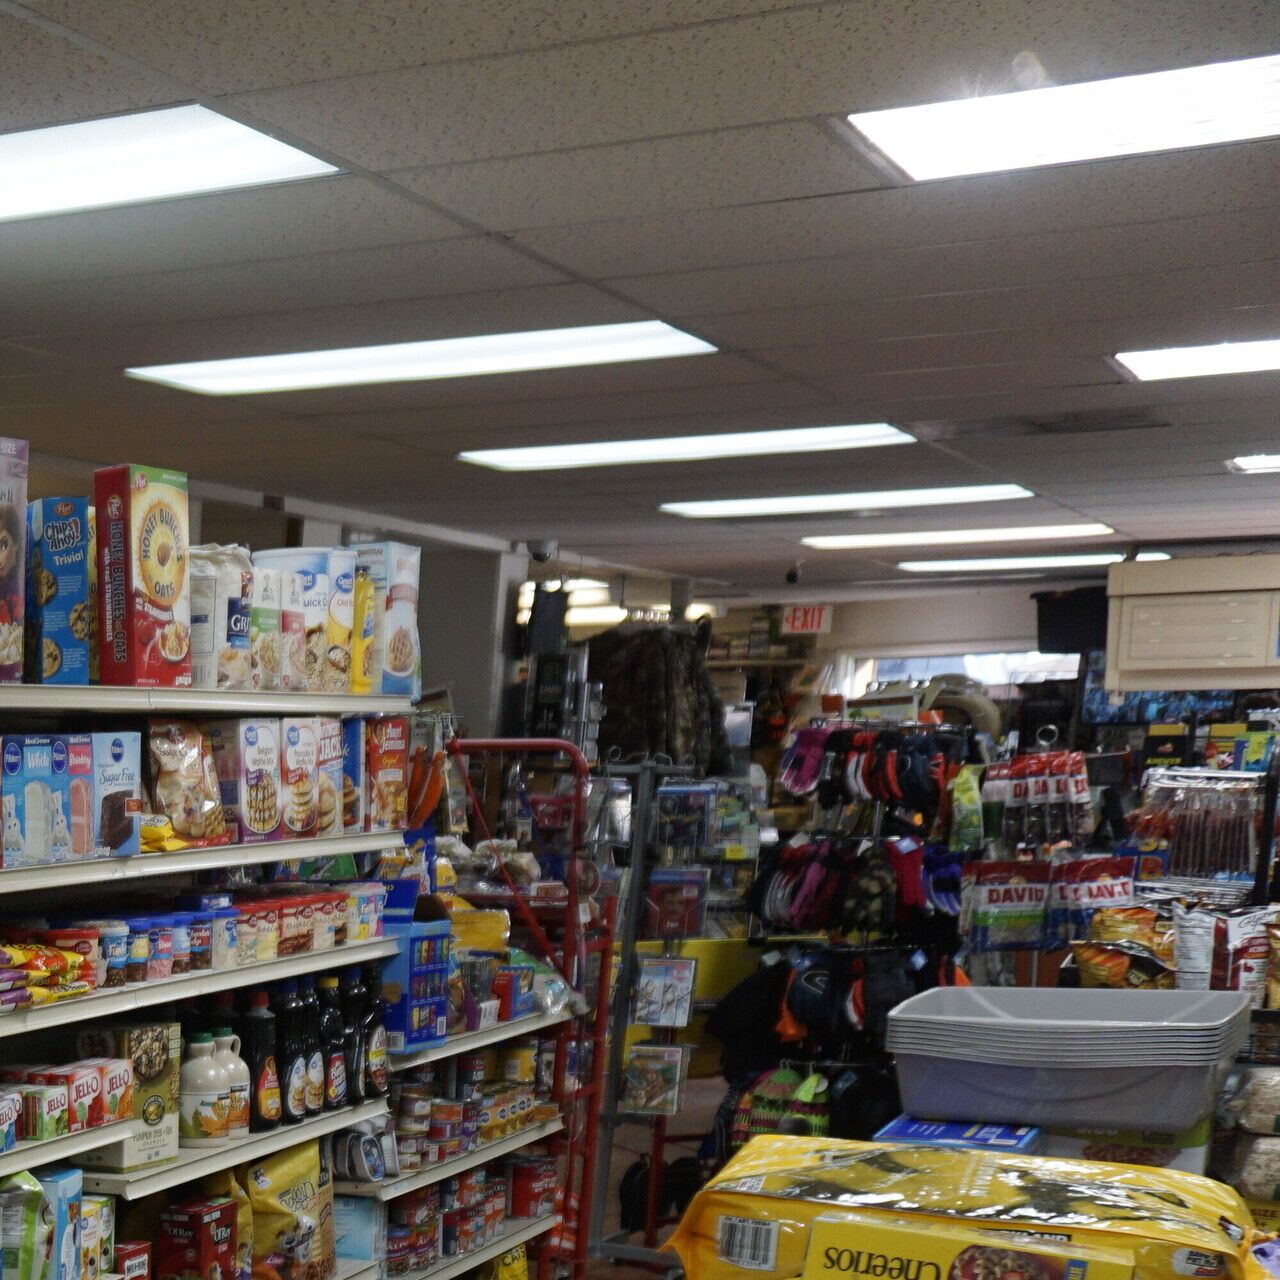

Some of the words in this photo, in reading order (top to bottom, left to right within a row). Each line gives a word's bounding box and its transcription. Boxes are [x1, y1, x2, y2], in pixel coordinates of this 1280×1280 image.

[42, 518, 80, 542] Chips
[49, 530, 81, 552] Ahoy!
[142, 516, 158, 560] HONEY
[158, 508, 186, 565] BUNCHES
[53, 552, 85, 567] Trivia!
[154, 581, 175, 600] OATS
[792, 606, 825, 632] EXIT
[989, 885, 1045, 905] DAVID
